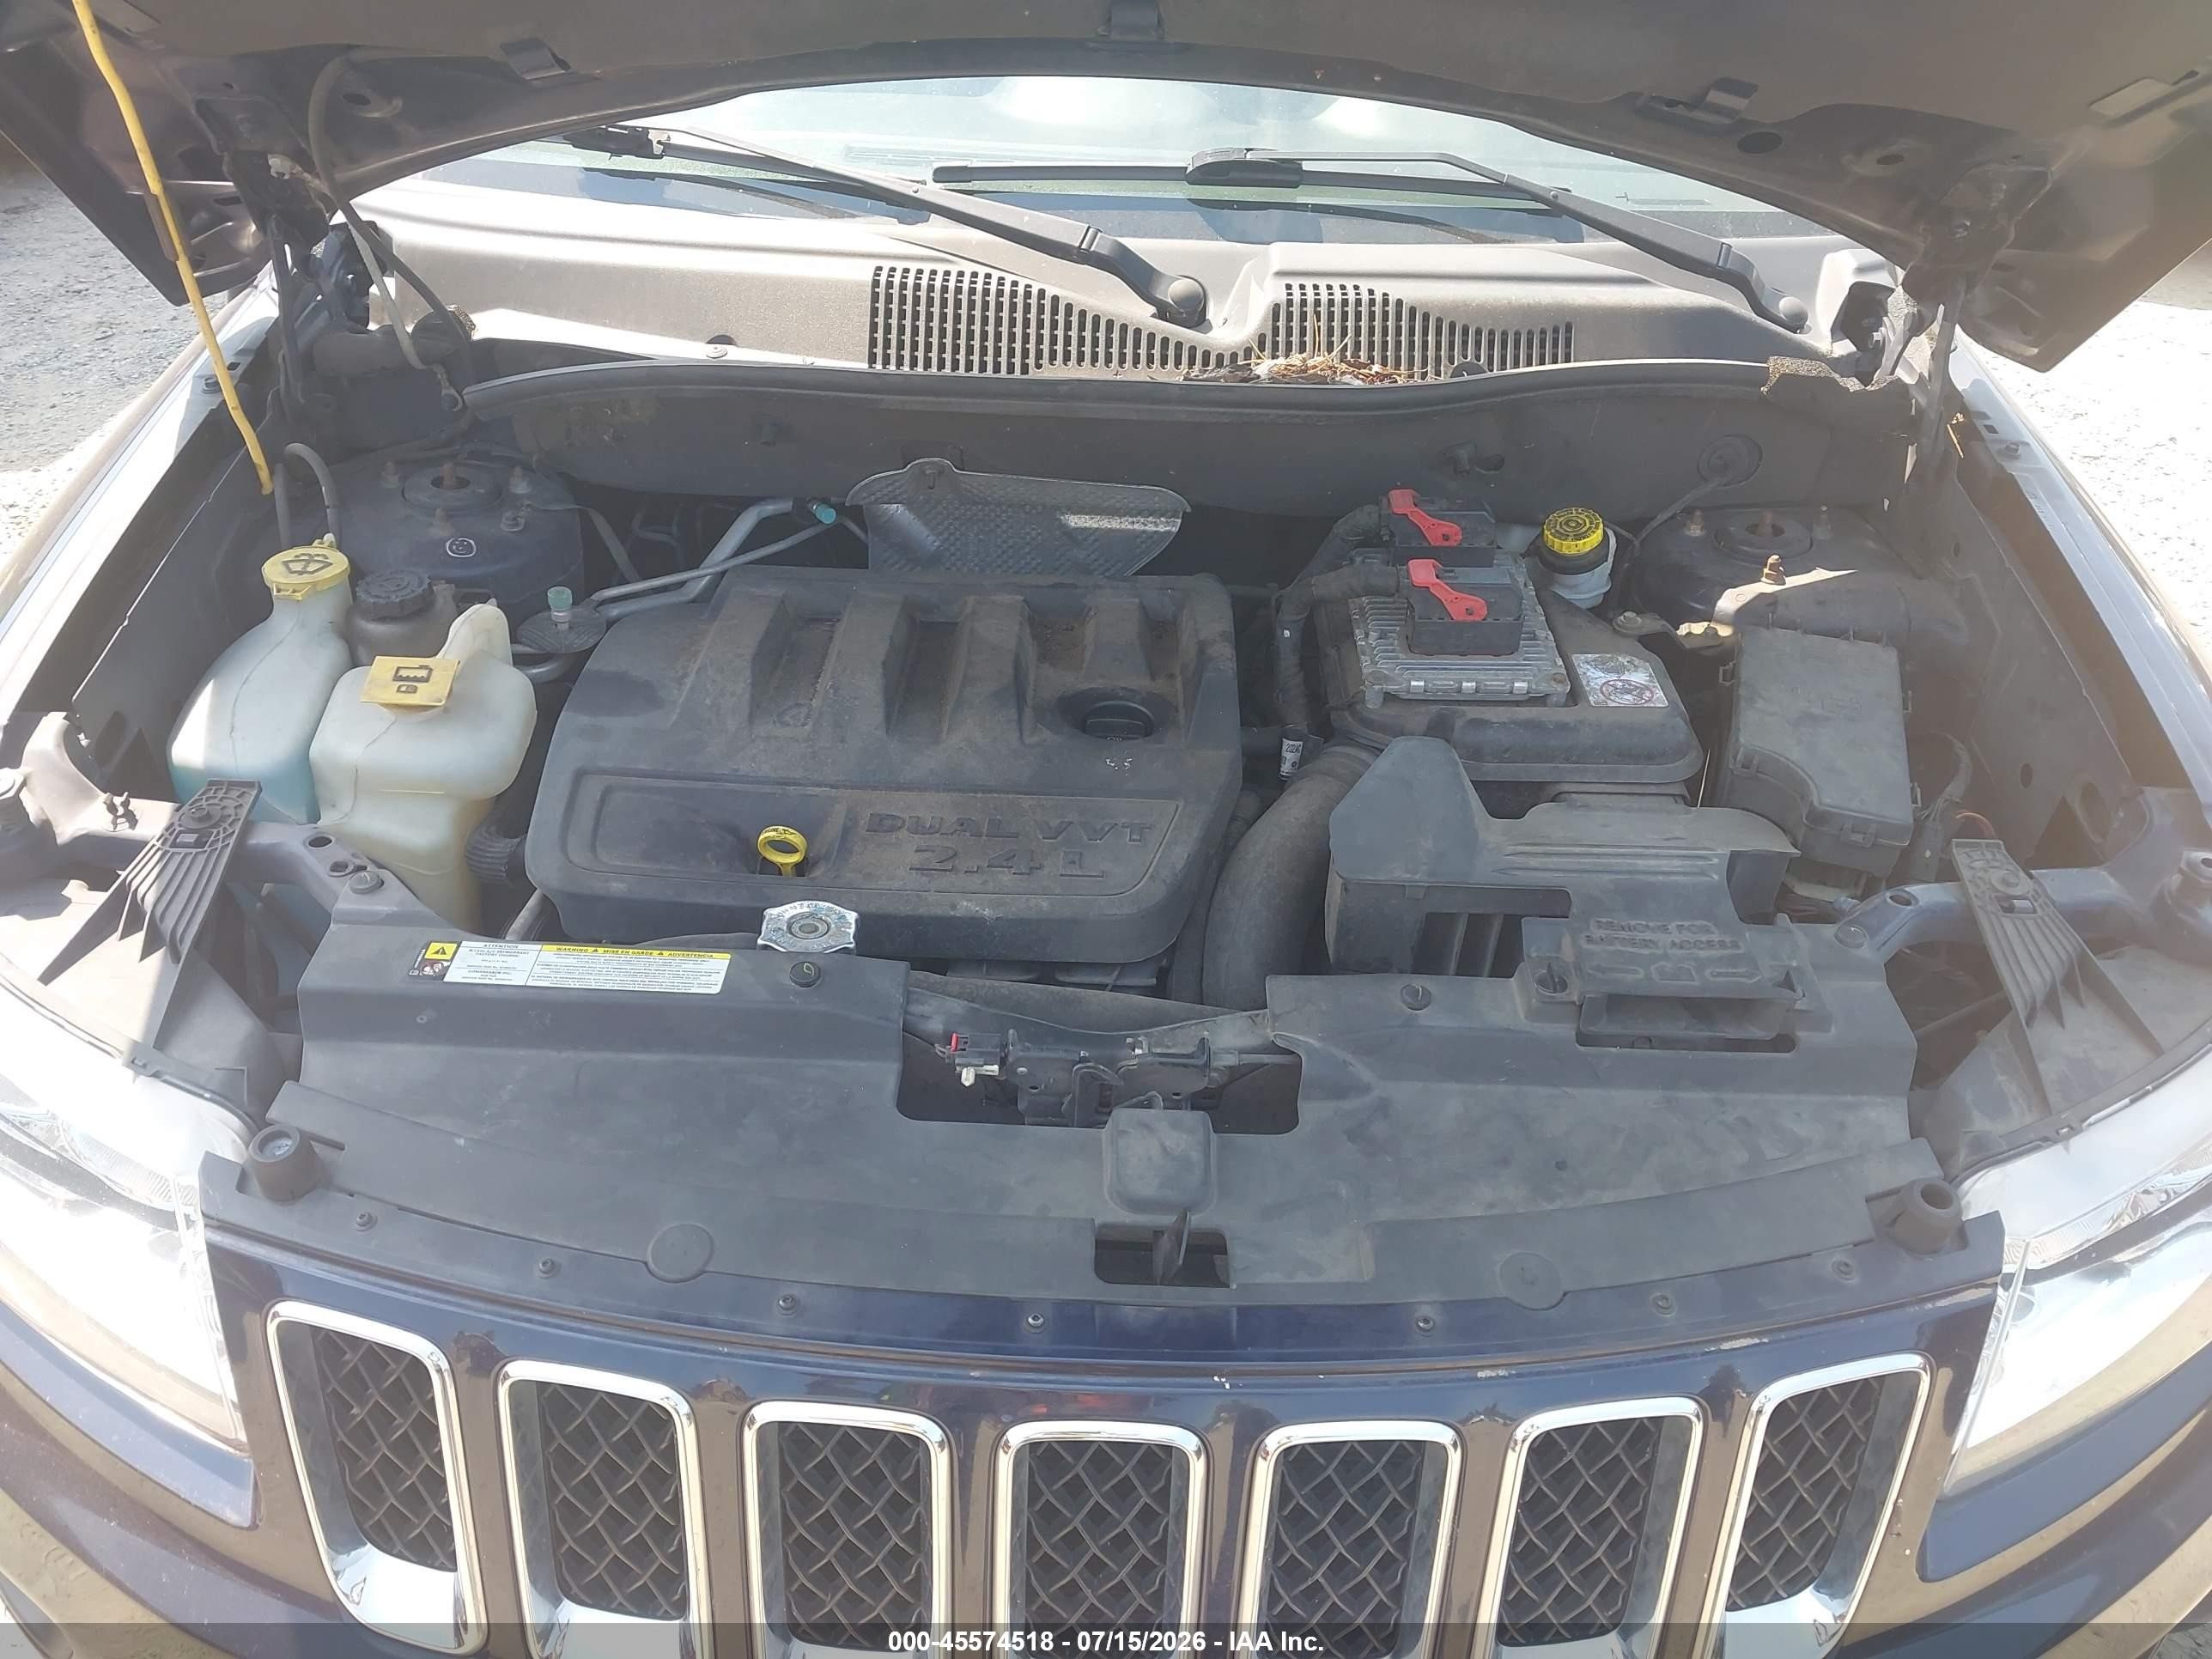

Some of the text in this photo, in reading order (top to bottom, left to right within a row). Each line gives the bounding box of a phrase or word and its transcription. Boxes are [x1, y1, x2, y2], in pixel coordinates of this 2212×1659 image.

[866, 812, 1153, 843] DUAL VVT
[908, 844, 1104, 879] 2.4L
[1670, 938, 1741, 951] ACCESS
